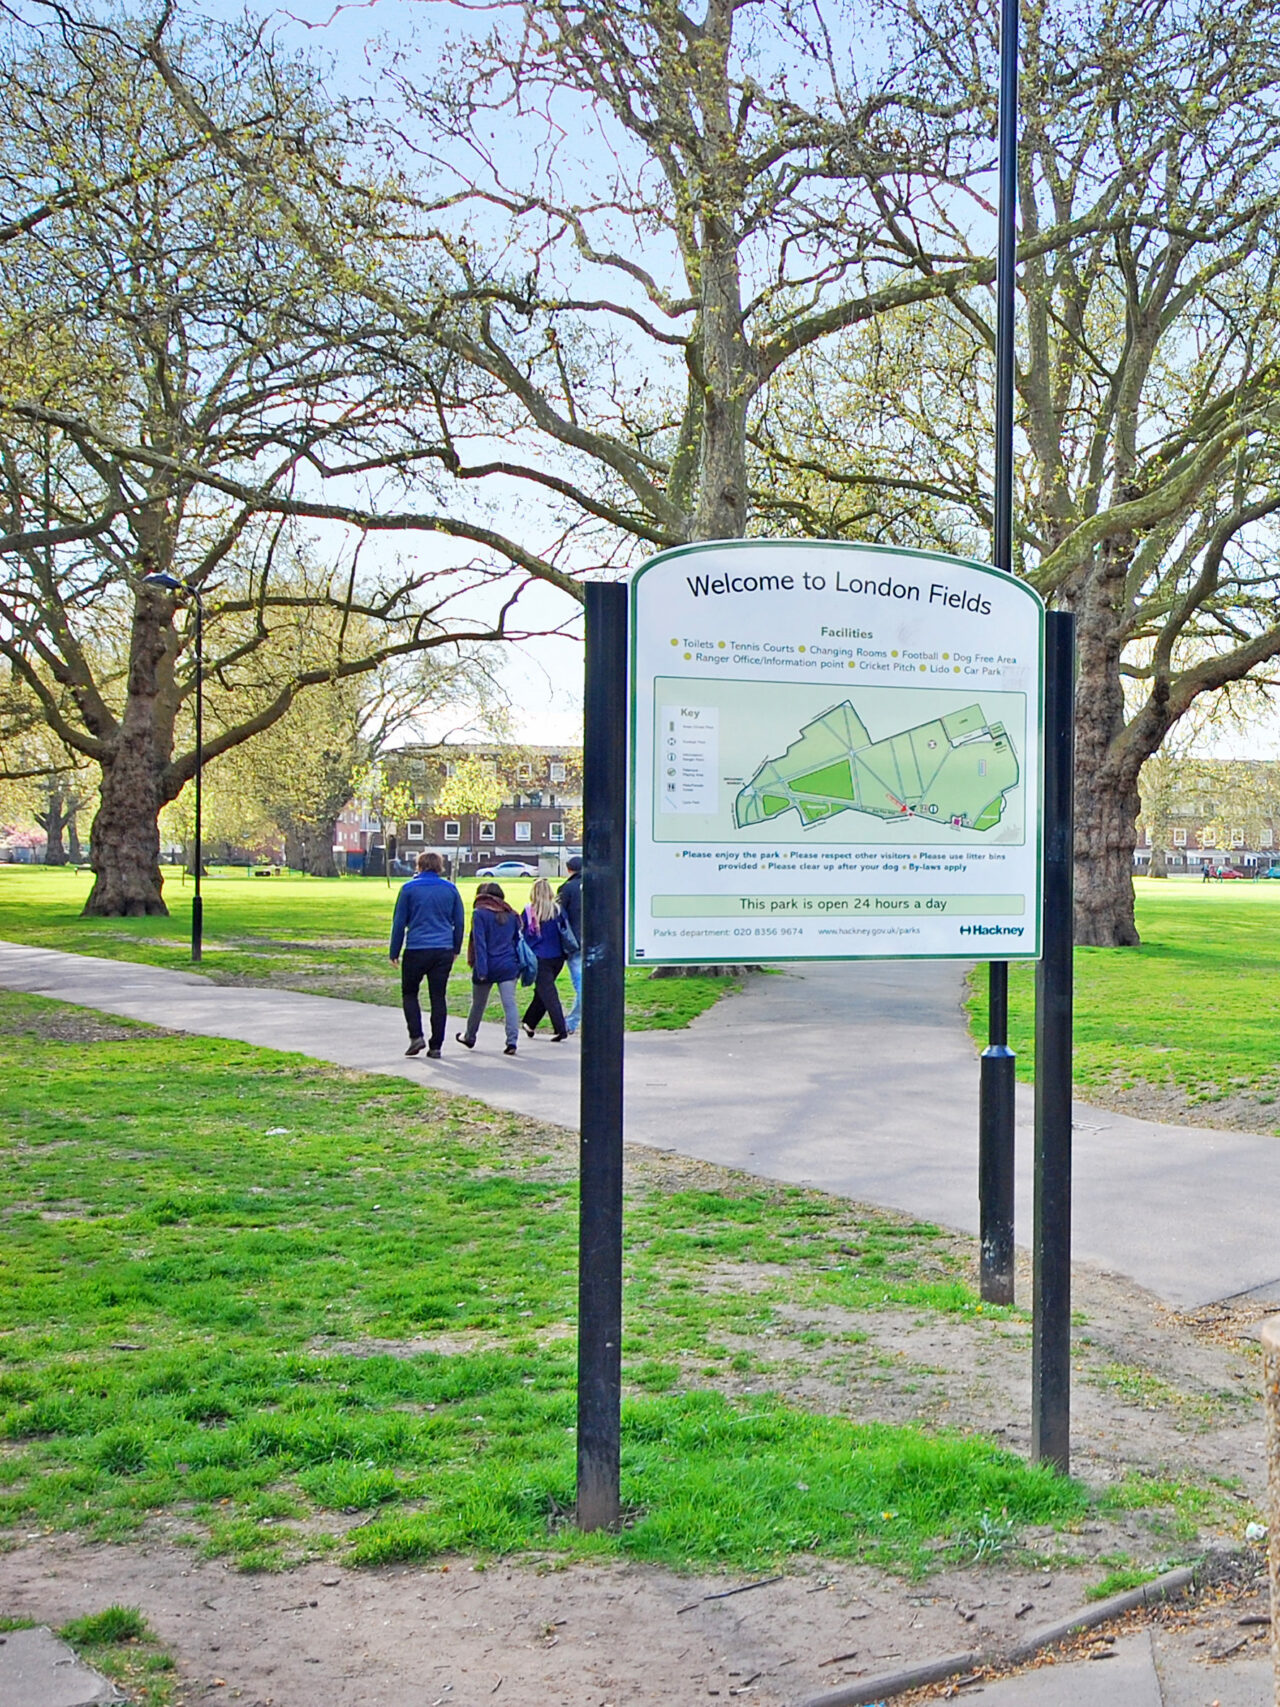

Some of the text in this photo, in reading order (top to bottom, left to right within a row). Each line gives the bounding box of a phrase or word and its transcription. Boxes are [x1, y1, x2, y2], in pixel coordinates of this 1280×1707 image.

[687, 571, 992, 615] Welcome to London Fields
[821, 627, 873, 639] Facilities
[683, 639, 1017, 664] Toilets Tennis Courts Changing Rooms Football Dog Free Area
[696, 653, 1001, 675] Ranger Office/Information point Cricket Pitch Lido Car Park
[681, 708, 700, 719] Key
[715, 851, 740, 860] enjoy
[760, 851, 779, 860] park
[821, 852, 852, 861] respect
[718, 863, 758, 871] provided
[882, 864, 899, 872] dog
[909, 864, 941, 872] By-laws
[944, 864, 967, 872] apply
[740, 898, 947, 912] This park is open 24 hours a day
[653, 929, 677, 937] Parks
[733, 928, 752, 936] 020
[754, 928, 777, 936] 8356
[818, 927, 920, 936] www.hackney.gov.uk/parks
[973, 925, 1025, 936] Hackney
